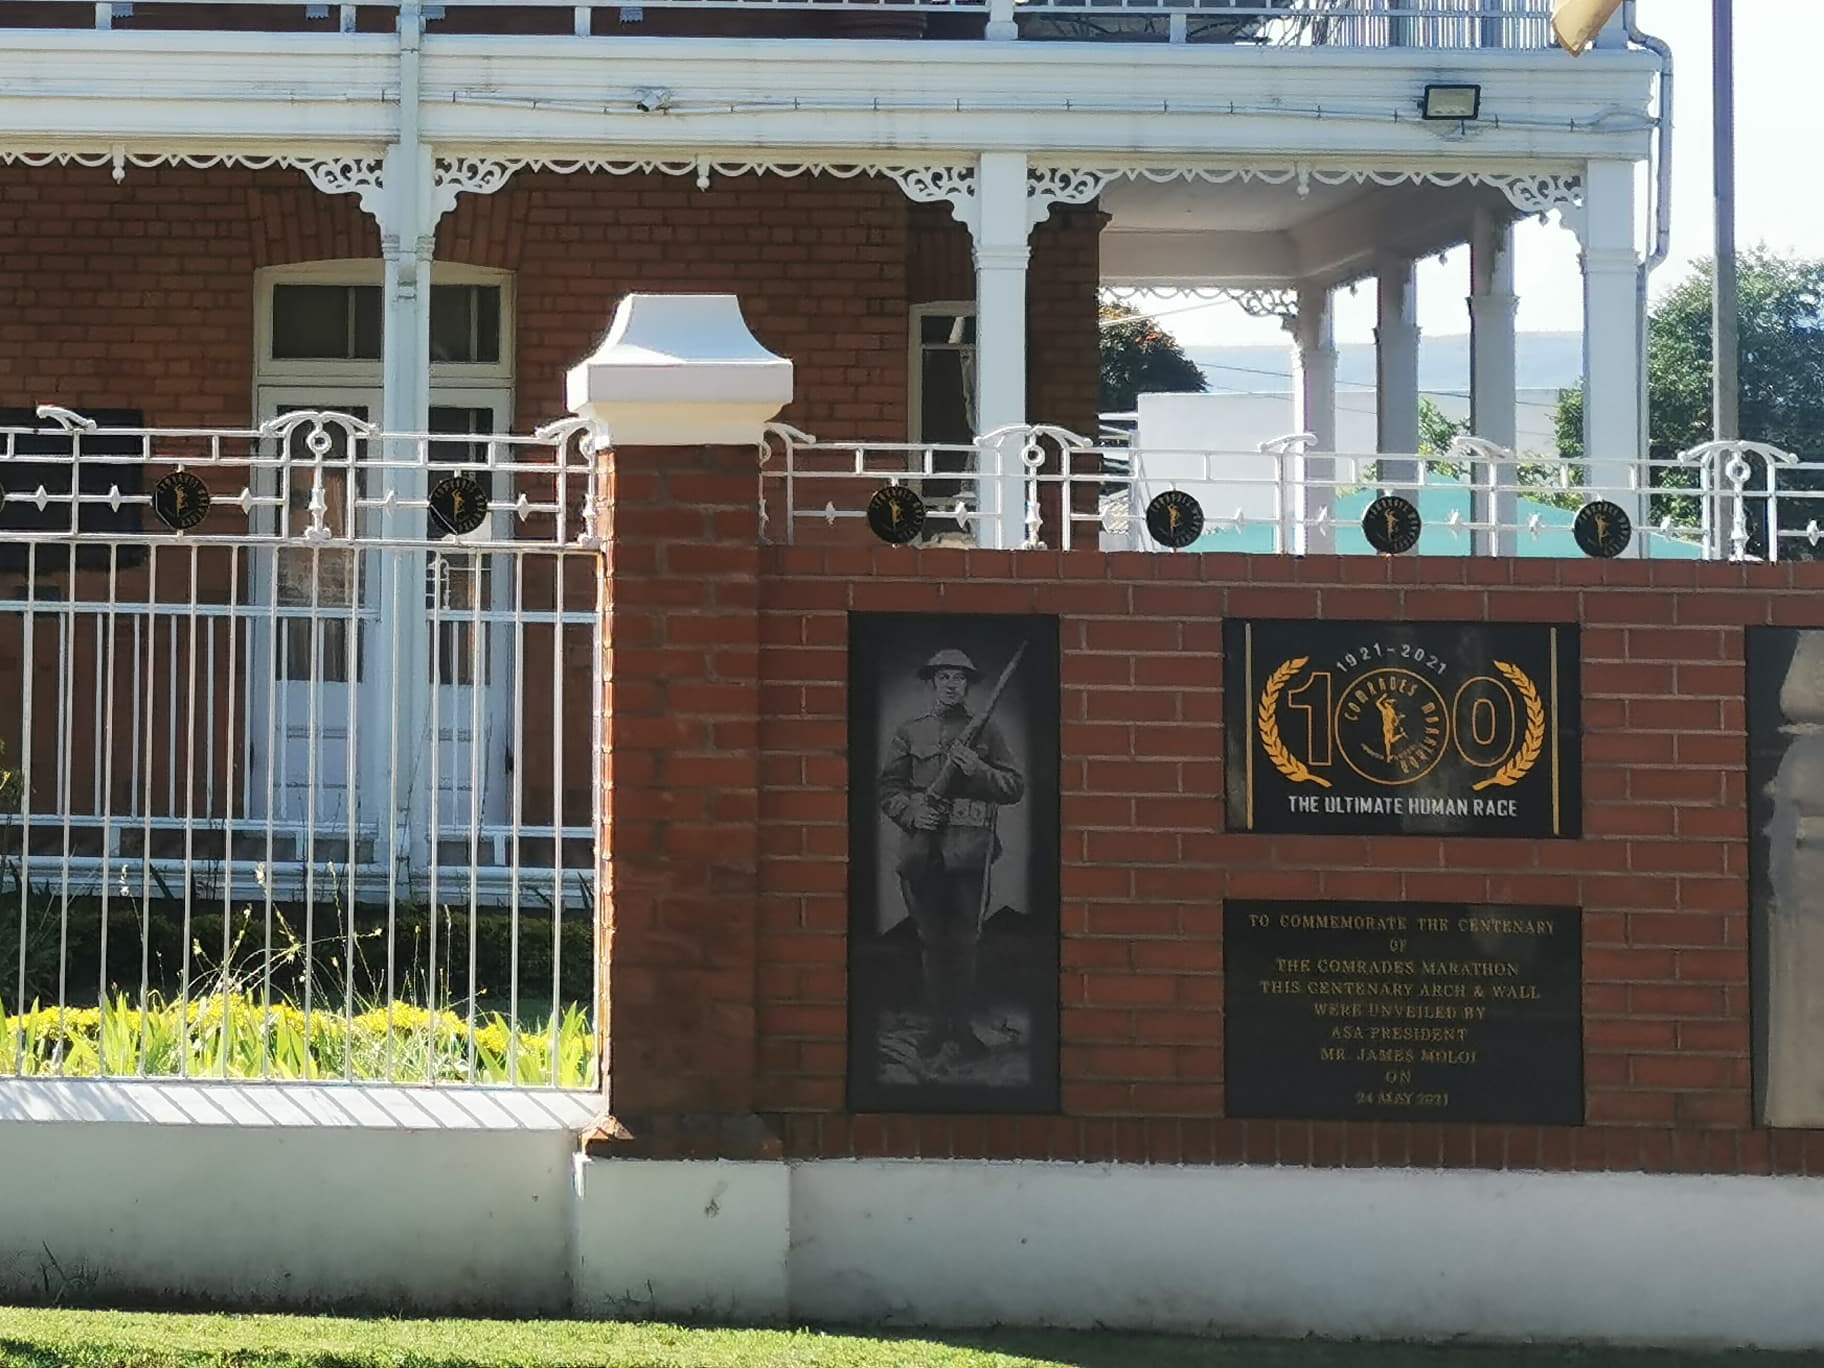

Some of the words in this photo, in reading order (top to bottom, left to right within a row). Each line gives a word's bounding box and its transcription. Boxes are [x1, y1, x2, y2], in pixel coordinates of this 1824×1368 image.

[1336, 642, 1448, 677] 1921-2021
[1288, 795, 1319, 813] THE
[1325, 796, 1403, 815] ULTIMATE
[1408, 797, 1469, 817] HUMAN
[1473, 799, 1517, 817] RACE
[1249, 914, 1270, 928] TO
[1280, 914, 1407, 932] COMMEMORATE
[1417, 917, 1449, 933] THE
[1458, 918, 1554, 936] CENTENARY
[1389, 938, 1407, 953] OF
[1277, 958, 1310, 973] THE
[1317, 959, 1414, 975] COMRADES
[1422, 961, 1520, 977] MARATHON
[1260, 980, 1301, 994] THIS
[1307, 981, 1412, 997] CENTENARY
[1420, 984, 1465, 998] ARCH
[1473, 985, 1484, 998] &
[1492, 986, 1541, 999] WALL
[1314, 1003, 1362, 1017] WERE
[1369, 1003, 1457, 1019] UNVEILED
[1464, 1006, 1486, 1020] BY
[1331, 1025, 1364, 1040] ASA
[1371, 1026, 1468, 1041] PRESIDENT
[1356, 1048, 1414, 1063] JAMES
[1385, 1070, 1412, 1084] ON
